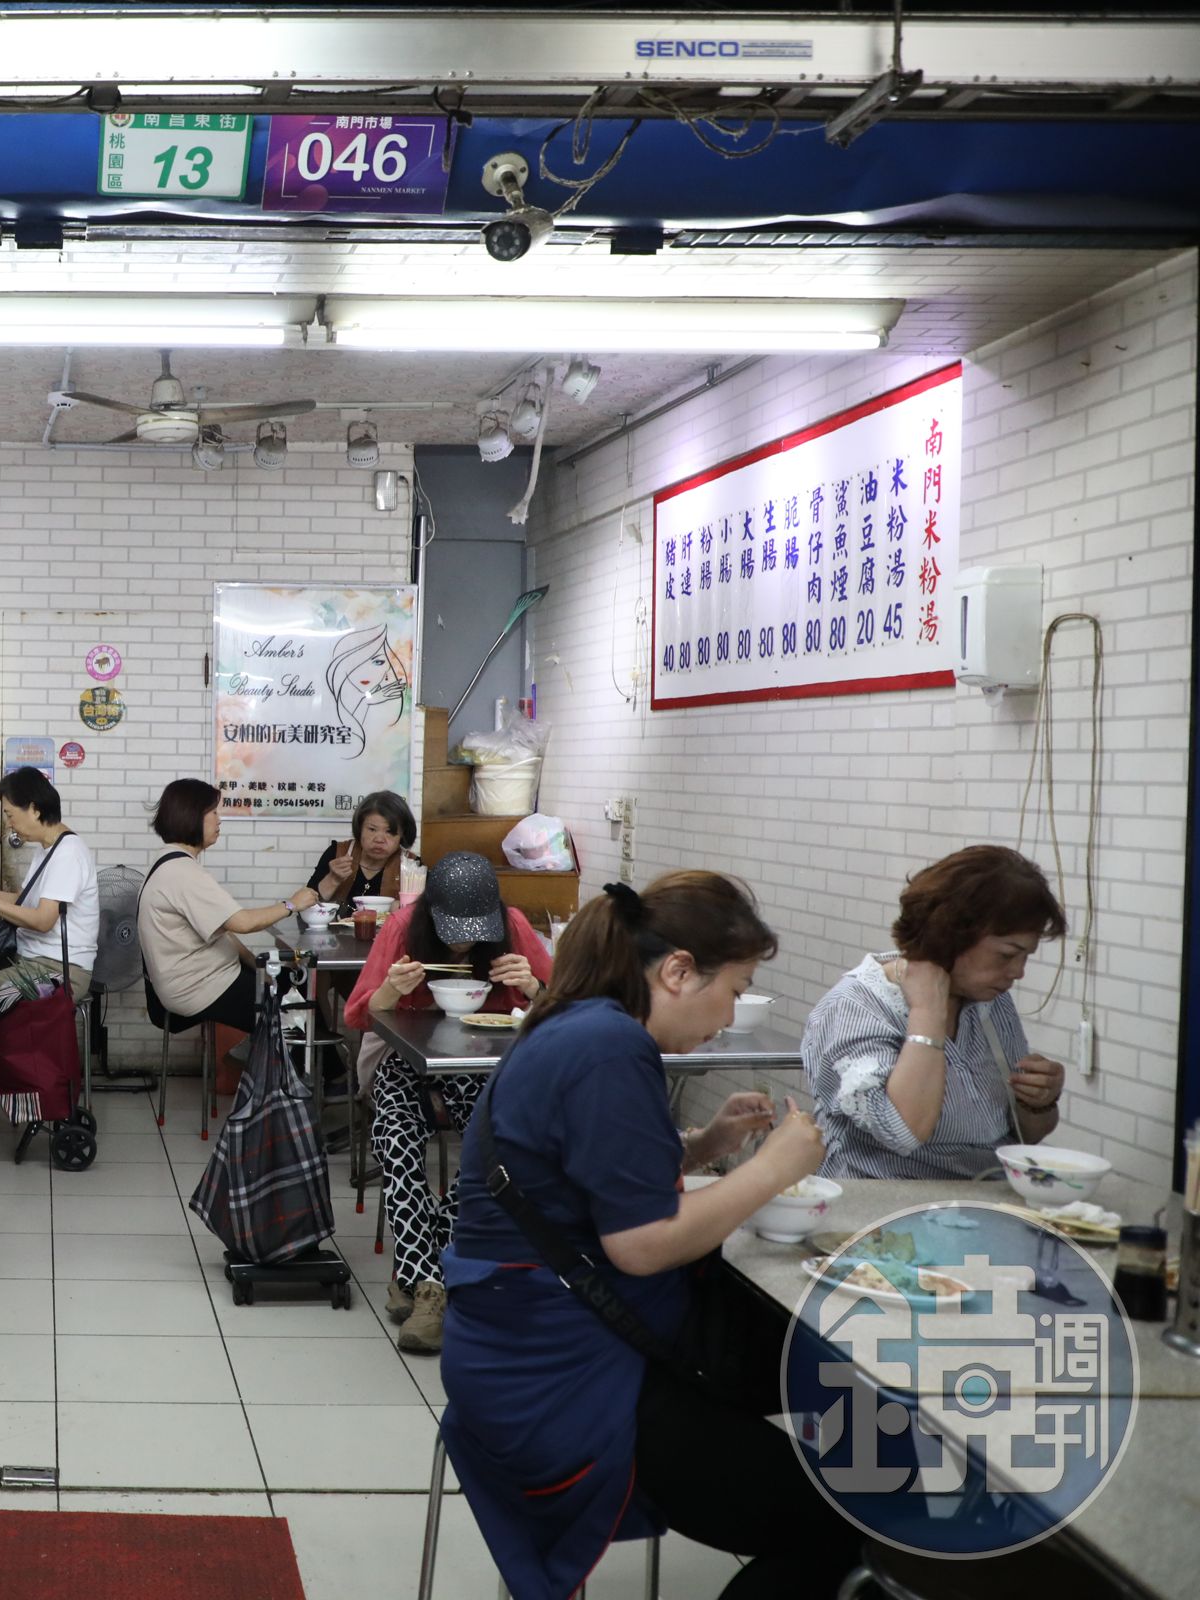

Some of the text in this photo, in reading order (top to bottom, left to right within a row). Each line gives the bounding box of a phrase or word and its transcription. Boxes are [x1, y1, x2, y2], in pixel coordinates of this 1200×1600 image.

[636, 41, 739, 57] SENCO
[107, 133, 126, 190] 桃園區
[143, 114, 237, 129] 南昌東街
[153, 145, 214, 190] 13
[298, 132, 408, 183] 046
[335, 116, 393, 130] 南門市場
[679, 530, 694, 669] 肝連 80
[697, 525, 712, 666] 粉腸 80
[717, 518, 733, 661] 小腸 80
[737, 510, 755, 660] 大腸 80
[759, 500, 777, 658] 生腸 80
[782, 495, 800, 655] 脆腸 80
[805, 486, 824, 652] 骨仔肉 80
[829, 480, 849, 650] 鯊魚煙 80
[857, 471, 878, 646] 油豆腐 20
[883, 458, 908, 640] 米粉湯 45
[918, 418, 943, 643] 南門米粉湯
[244, 635, 305, 658] Amber's
[663, 538, 676, 672] 豬皮 40
[223, 724, 351, 745] 安柏的玩美研究室
[227, 673, 316, 702] Beauty Studio
